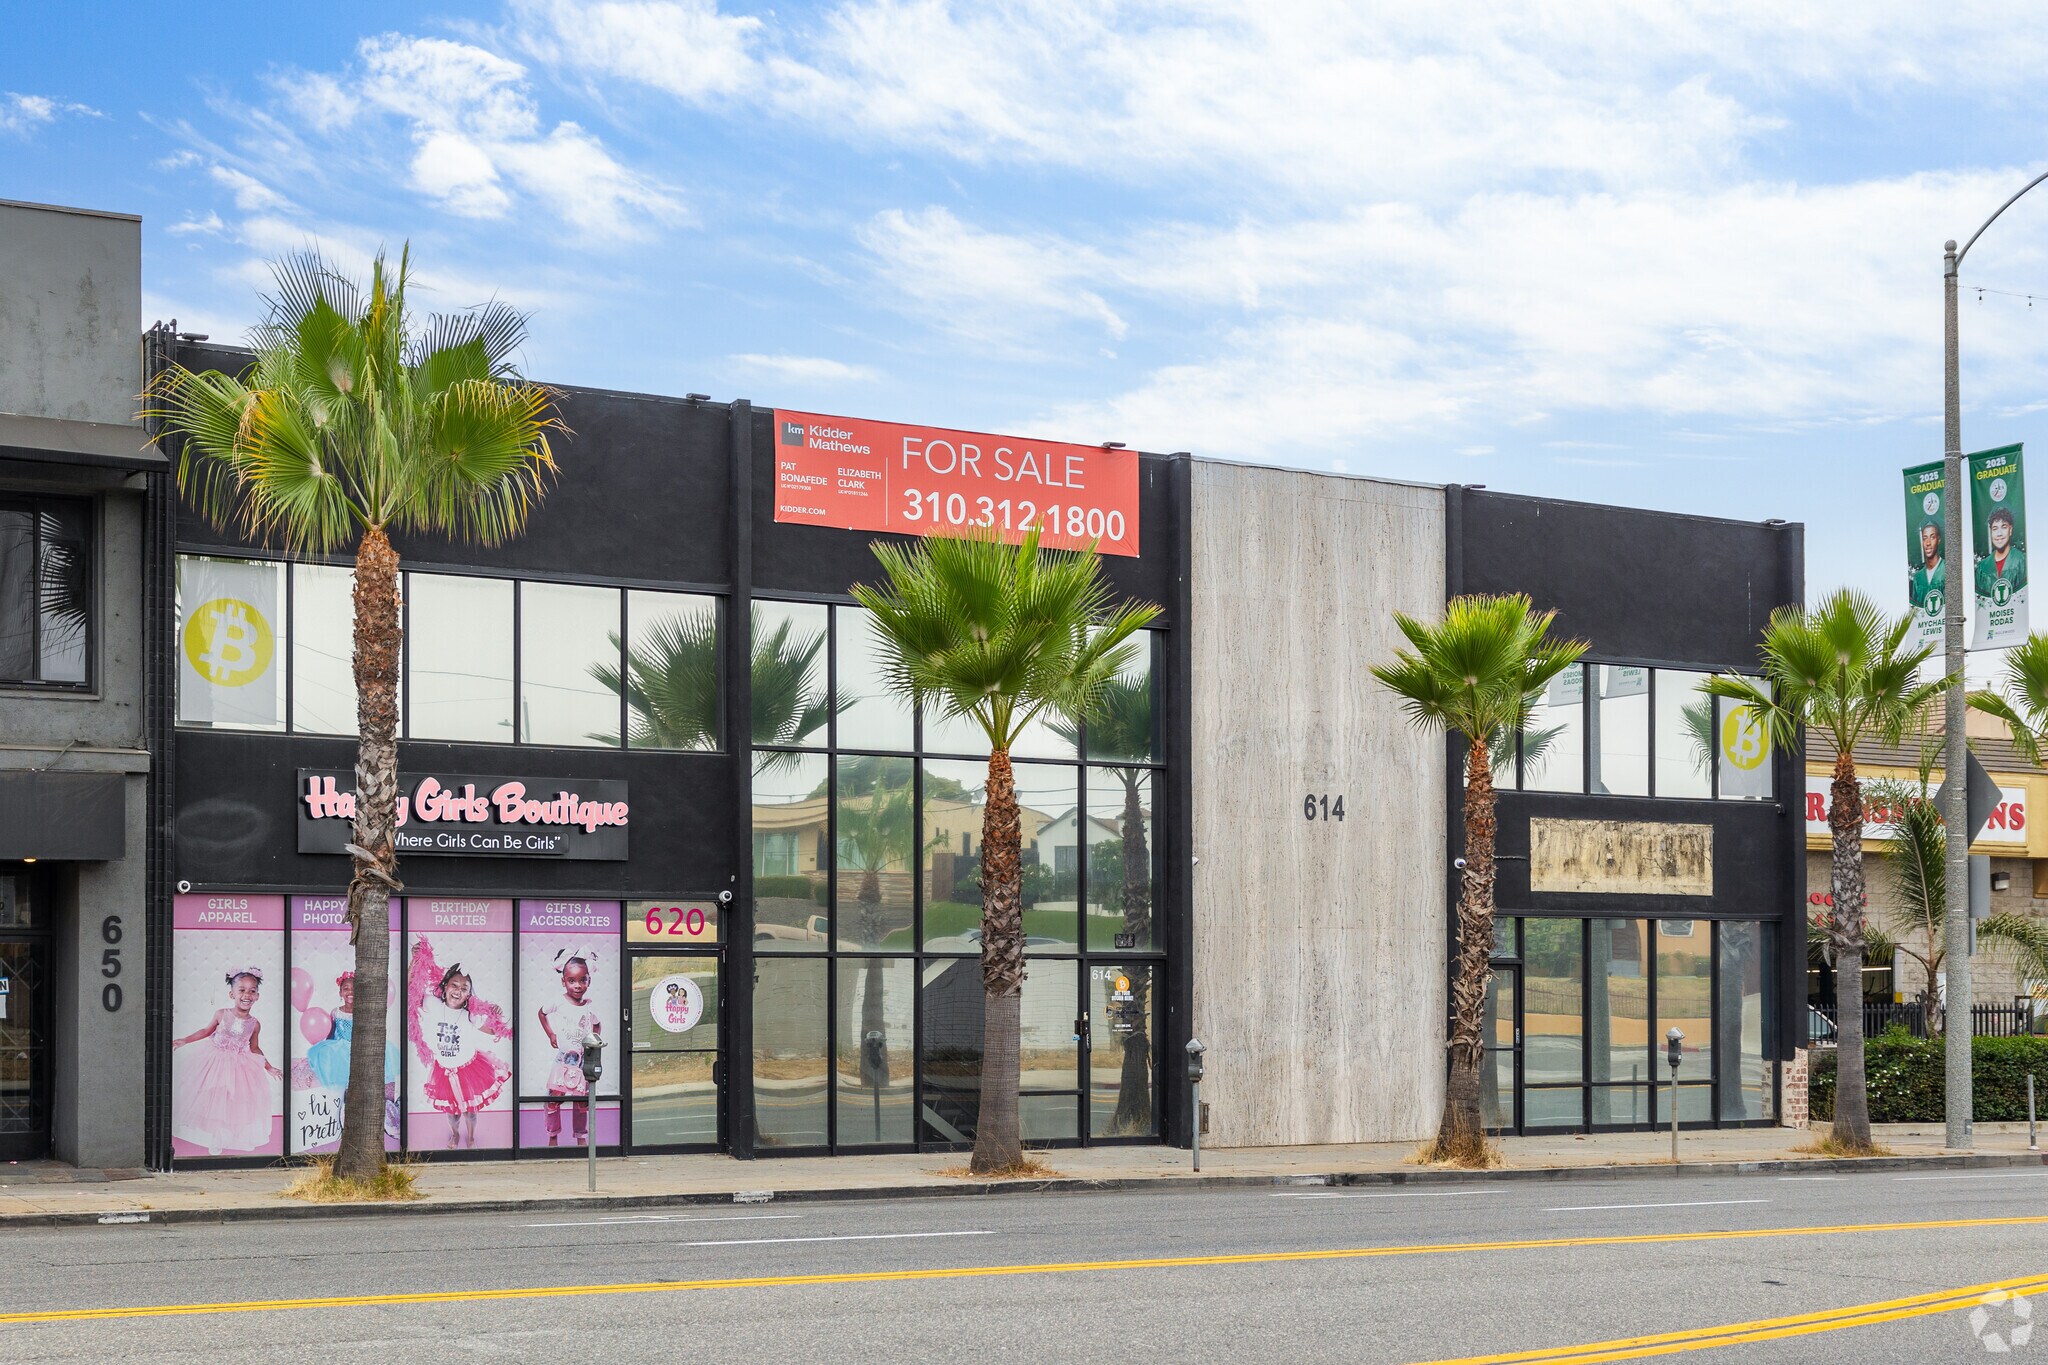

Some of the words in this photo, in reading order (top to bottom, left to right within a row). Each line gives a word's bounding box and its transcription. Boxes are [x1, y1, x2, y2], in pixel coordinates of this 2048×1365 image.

[788, 423, 804, 434] km
[809, 425, 853, 440] Kidder
[809, 438, 871, 455] Mathews
[781, 462, 797, 471] PAT
[902, 436, 982, 479] FOR
[993, 447, 1086, 490] SALE
[1985, 457, 2007, 470] 2025
[837, 468, 882, 480] ELIZABETH
[1919, 471, 1939, 483] 2025
[1976, 464, 2018, 481] GRADUATE
[781, 473, 828, 486] BONAFEDE
[837, 479, 865, 490] CLARK
[1910, 479, 1945, 495] GRADUAT
[780, 505, 826, 516] KIDDER.COM
[902, 488, 1126, 541] 310.312.1800
[1990, 608, 2015, 619] MOISES
[1918, 618, 1945, 629] MYCHAE
[1990, 617, 2014, 626] RODAS
[1923, 627, 1942, 636] LEWIS
[305, 775, 410, 828] Hay
[414, 776, 490, 824] Girls
[491, 781, 629, 834] Boutique
[1304, 794, 1345, 821] 614
[436, 833, 466, 849] Girls
[470, 834, 500, 850] Can
[503, 835, 522, 850] Be
[207, 898, 248, 910] GIRLS
[304, 899, 347, 911] HAPPY
[431, 902, 490, 914] BIRTHDAY
[545, 903, 582, 914] GIFTS
[584, 903, 592, 914] &
[198, 911, 257, 924] APPAREL
[435, 915, 487, 926] PARTIES
[530, 915, 611, 927] ACCESSORIES
[645, 907, 706, 936] 620
[1092, 970, 1111, 980] 614
[665, 1001, 689, 1015] Happy
[668, 1013, 686, 1024] Girls
[436, 1033, 460, 1044] TOK
[309, 1093, 330, 1116] hi
